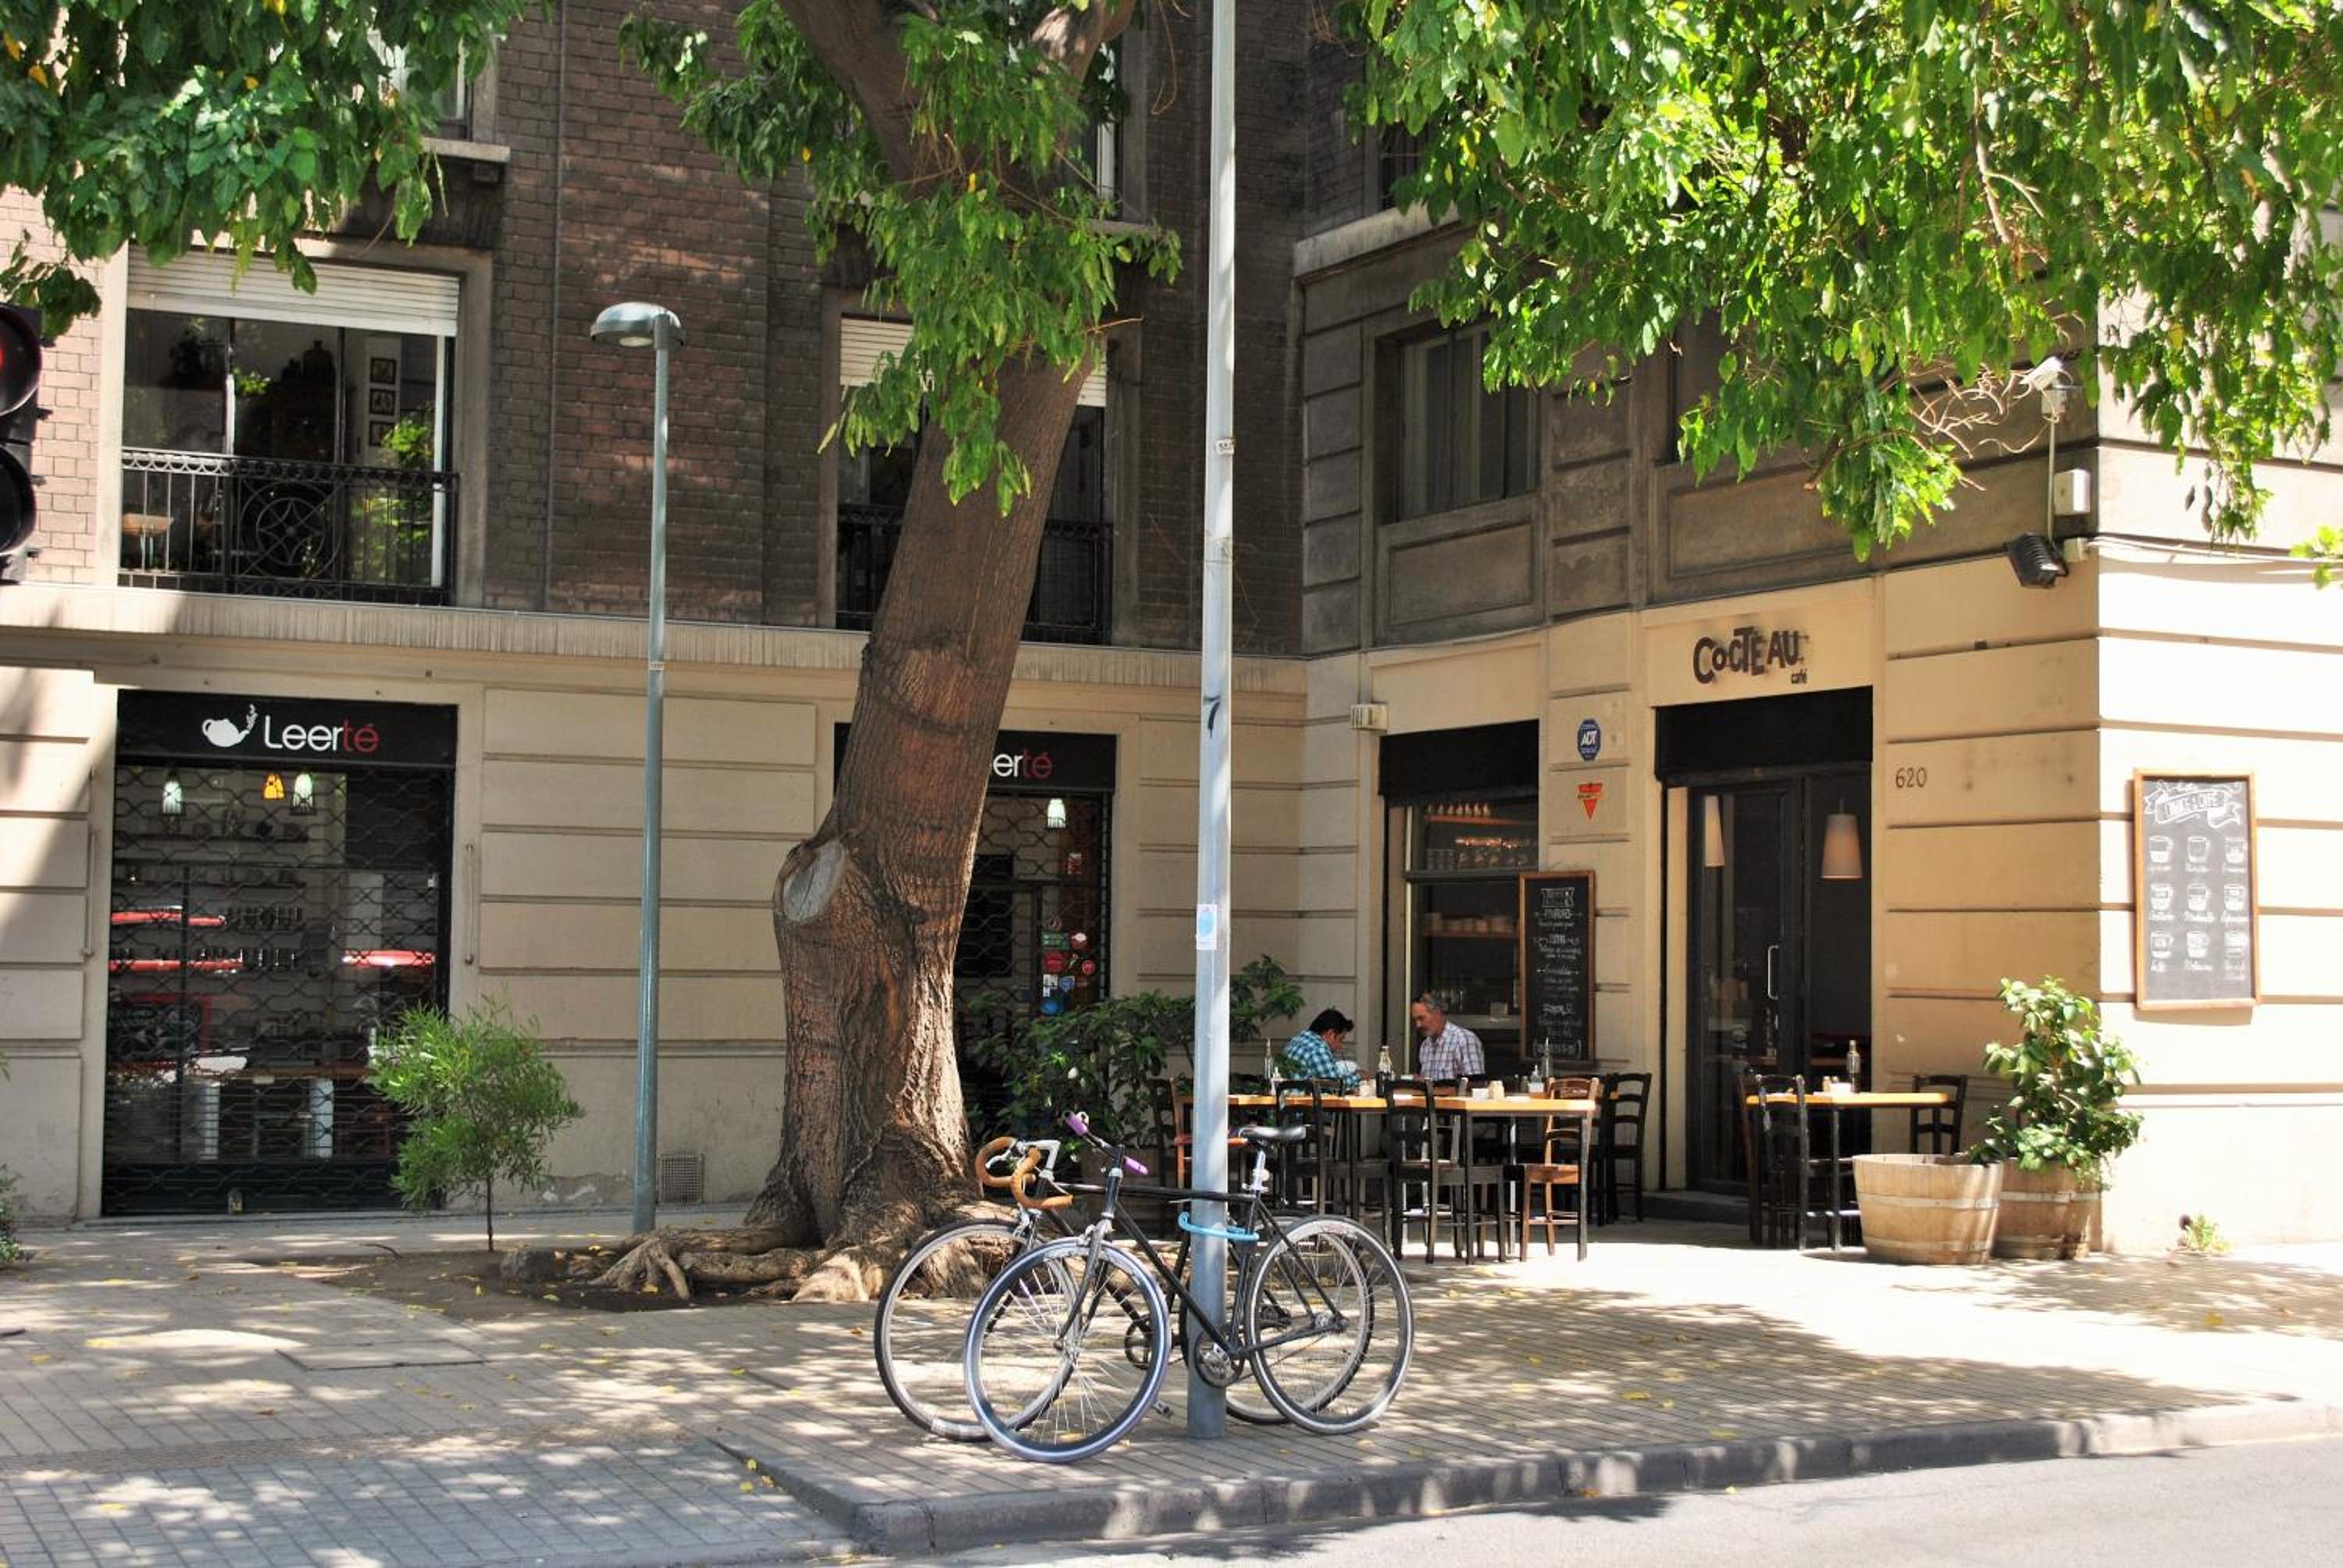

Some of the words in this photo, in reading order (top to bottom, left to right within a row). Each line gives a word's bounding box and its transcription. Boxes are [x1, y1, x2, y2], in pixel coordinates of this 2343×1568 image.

[264, 715, 379, 753] Leerté
[1580, 730, 1597, 746] ADT
[993, 749, 1051, 778] erté
[1895, 766, 1927, 788] 620
